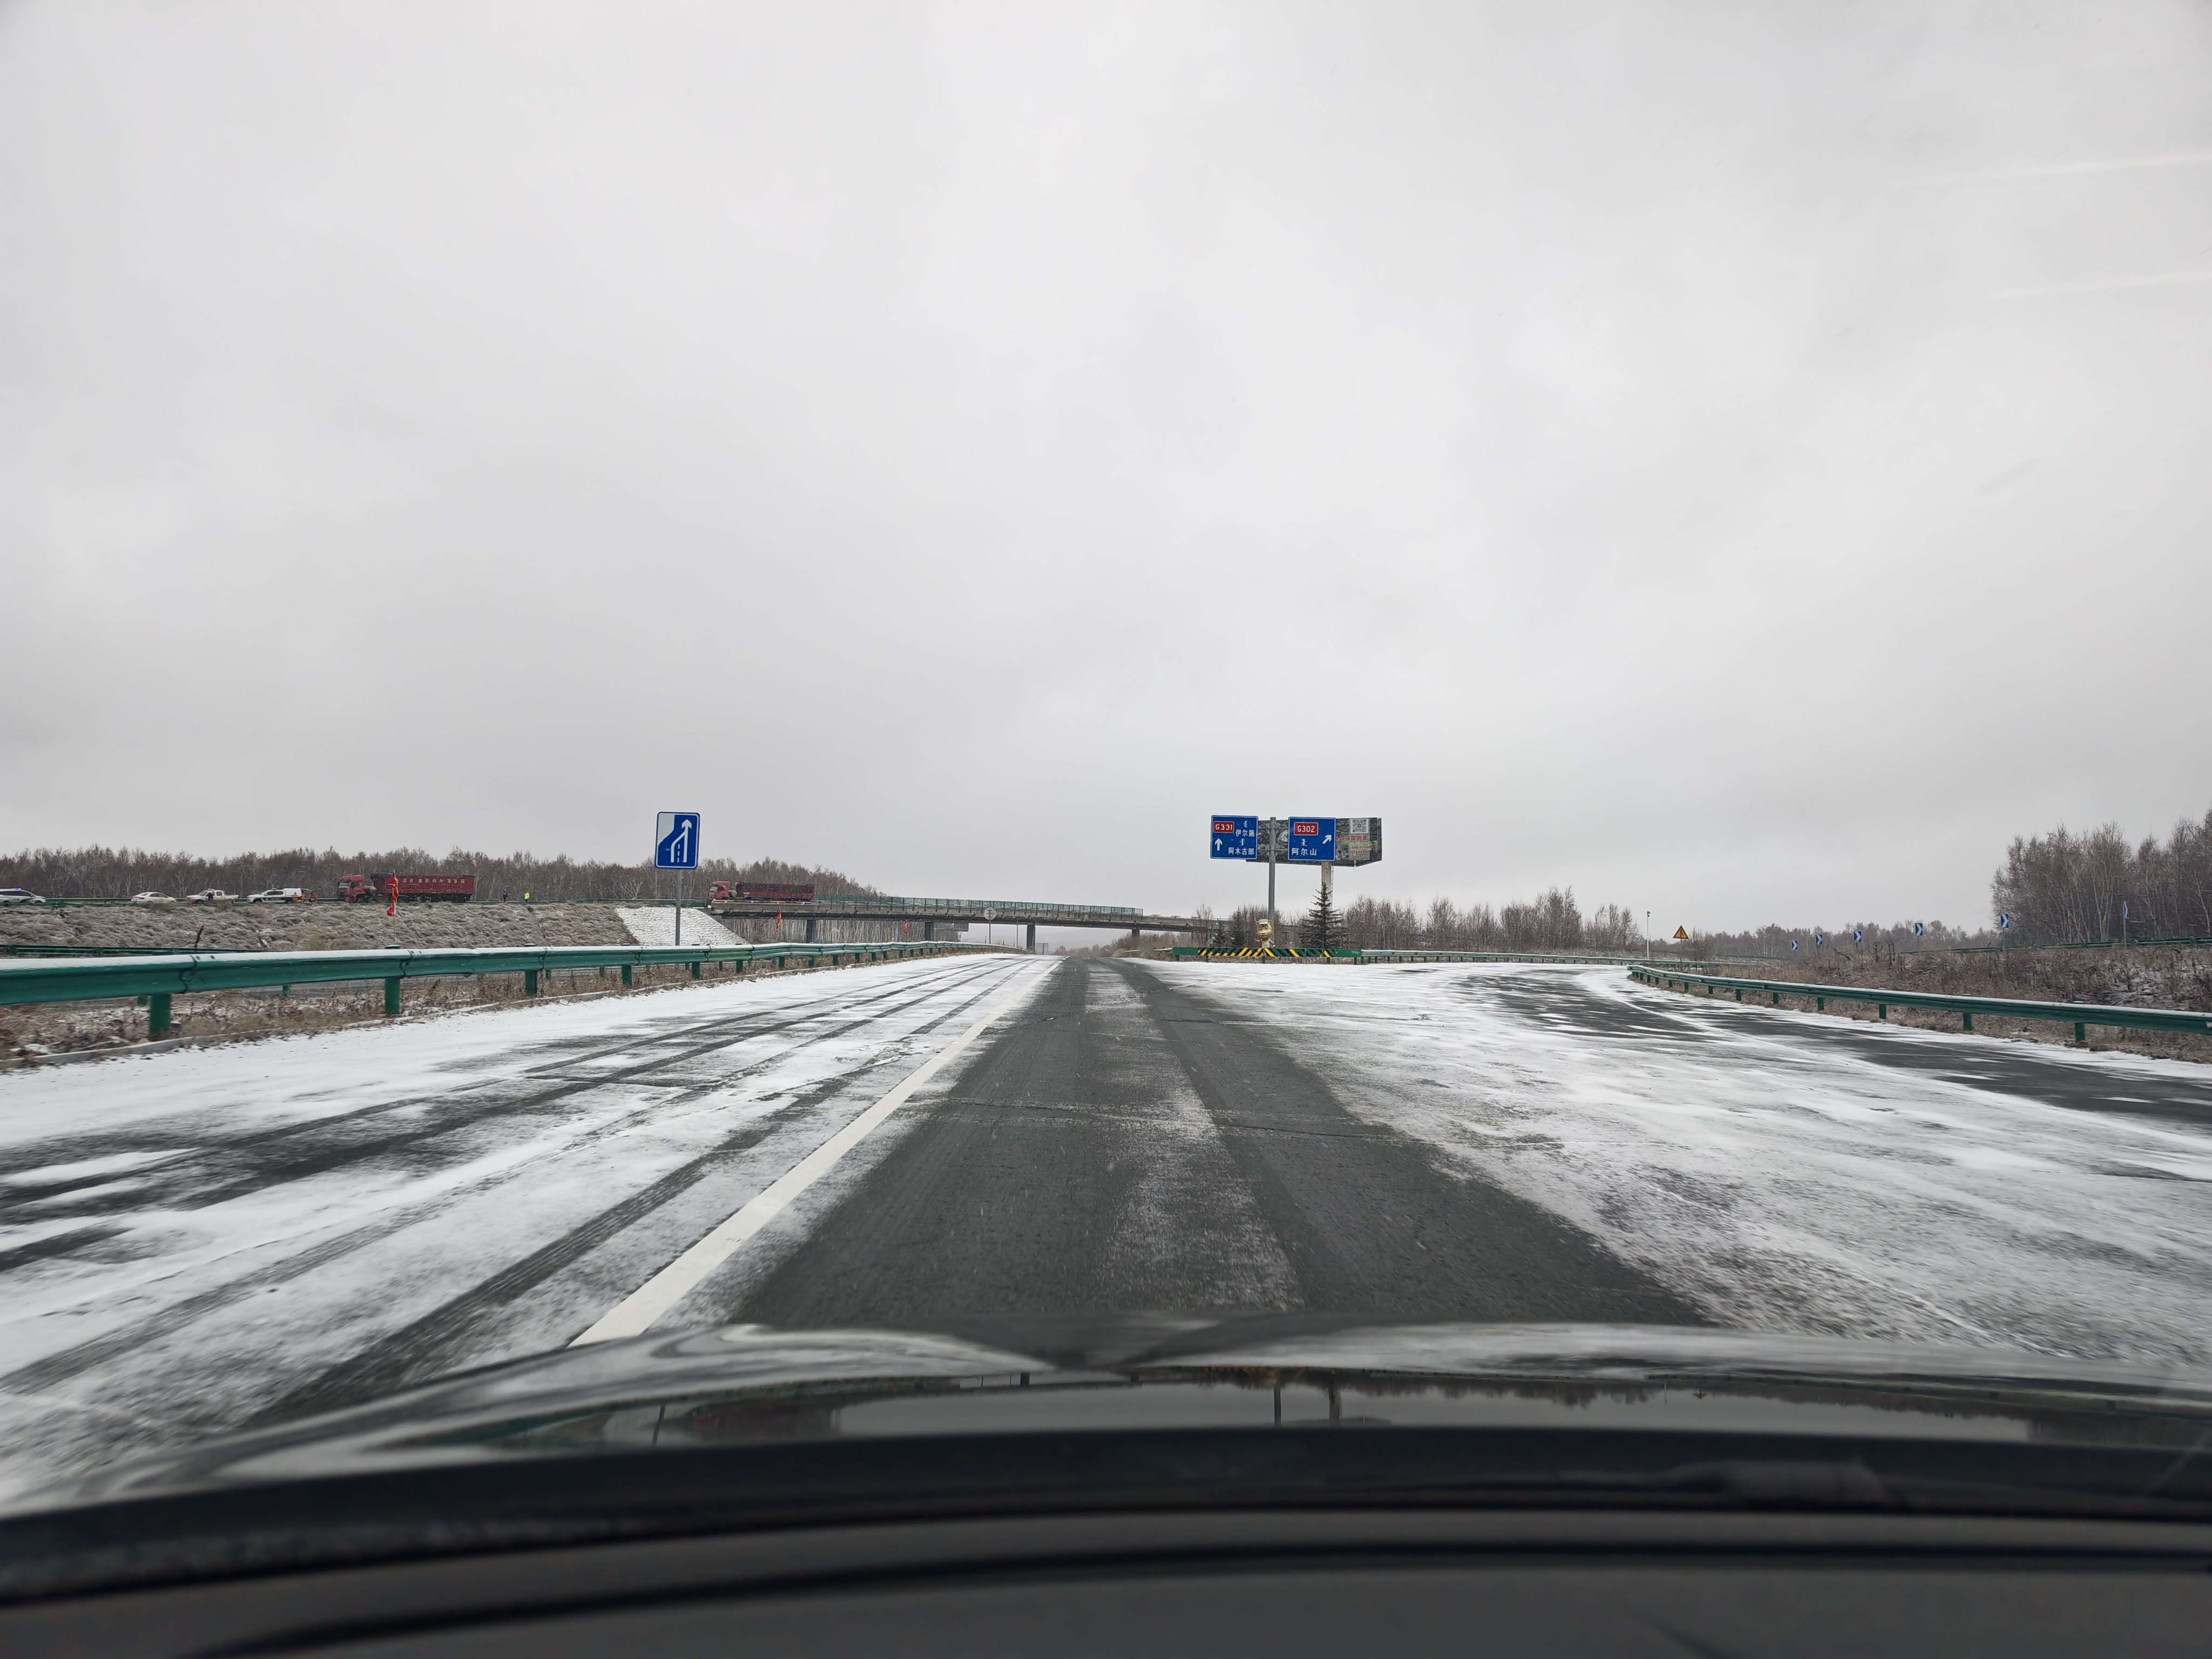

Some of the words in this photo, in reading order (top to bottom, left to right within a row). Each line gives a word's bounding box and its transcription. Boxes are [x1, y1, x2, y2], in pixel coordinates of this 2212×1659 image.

[1235, 828, 1255, 837] 伊尔施
[1228, 847, 1255, 856] 阿木古郎
[1291, 847, 1317, 856] 阿尔山
